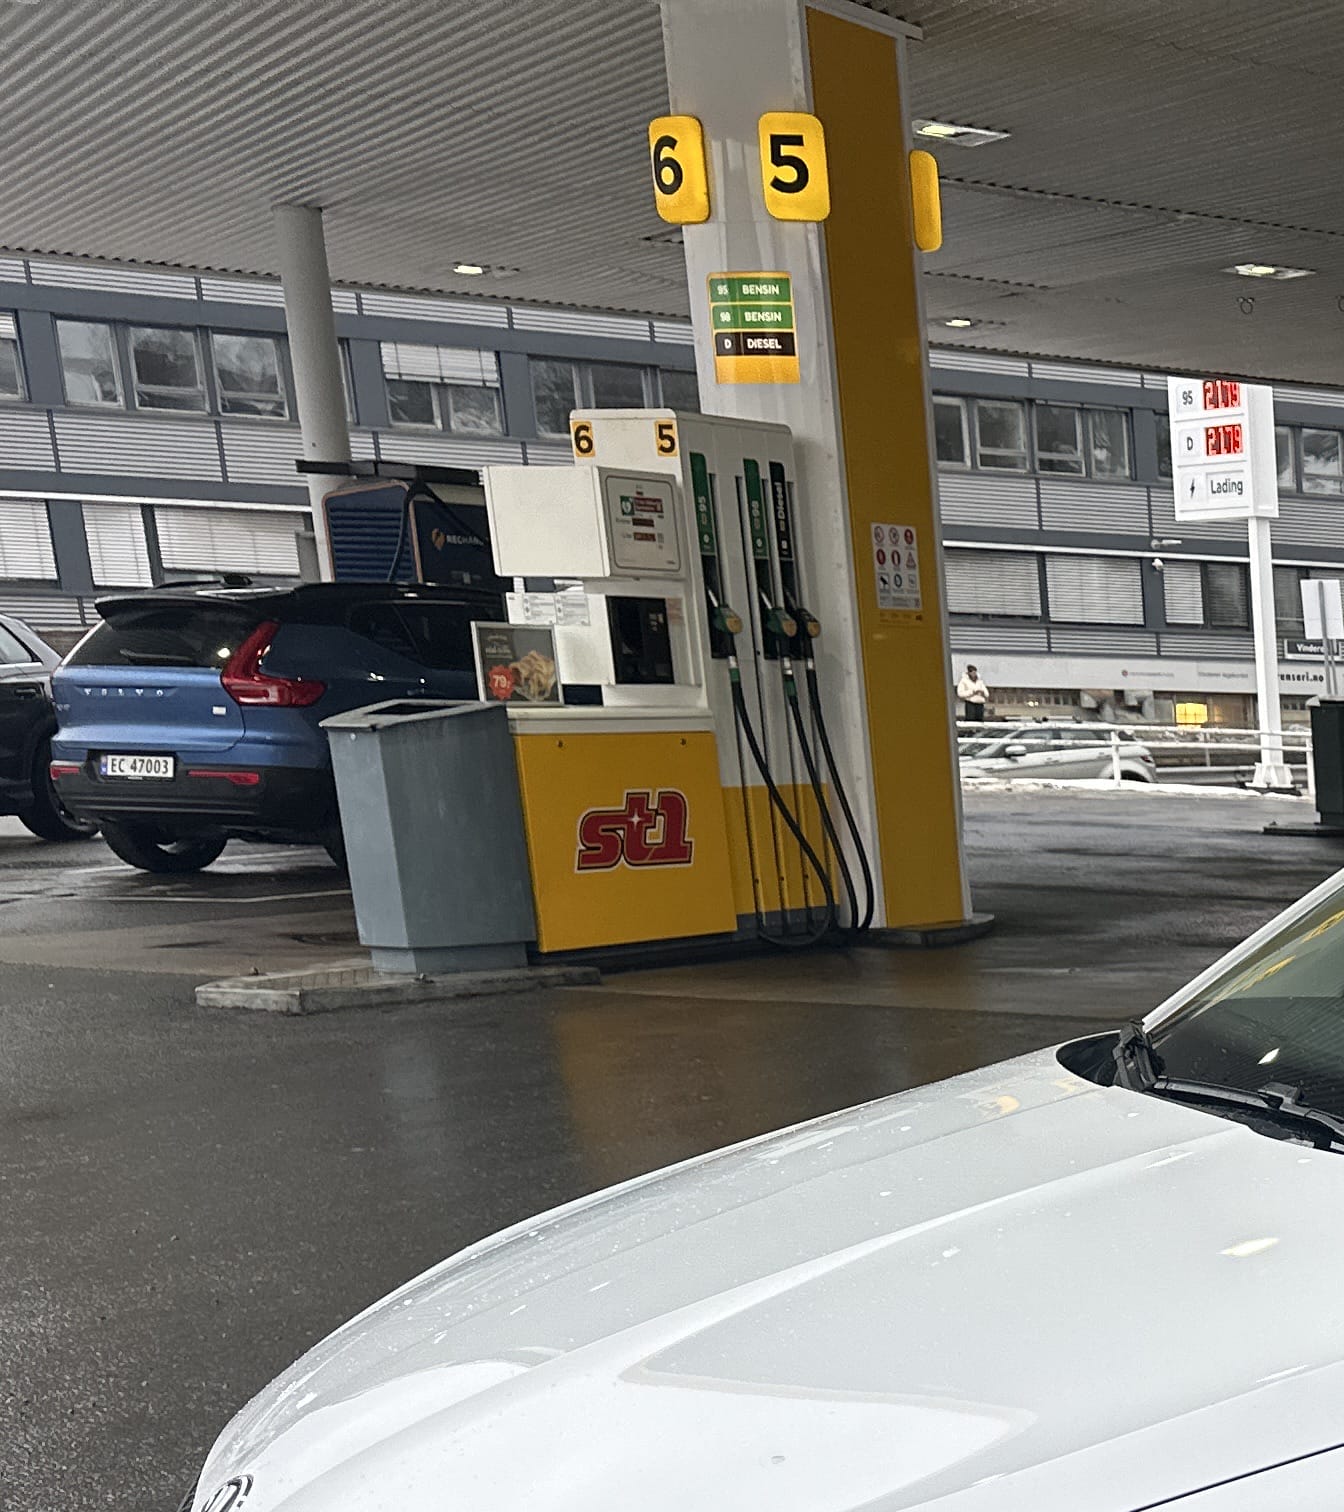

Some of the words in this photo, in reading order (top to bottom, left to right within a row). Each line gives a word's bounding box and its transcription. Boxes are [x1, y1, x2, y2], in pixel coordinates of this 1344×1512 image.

[653, 134, 683, 195] 6
[769, 133, 809, 194] 5
[742, 284, 780, 295] BENSIN
[744, 311, 782, 322] BENSIN
[724, 338, 732, 349] D
[747, 338, 782, 349] DIESEL
[1182, 390, 1193, 405] 95
[574, 424, 594, 454] 6
[657, 423, 676, 453] 5
[1187, 436, 1193, 451] D
[1210, 478, 1244, 496] Lading
[110, 759, 126, 773] EC
[130, 759, 169, 775] 47003
[575, 787, 695, 874] st1
